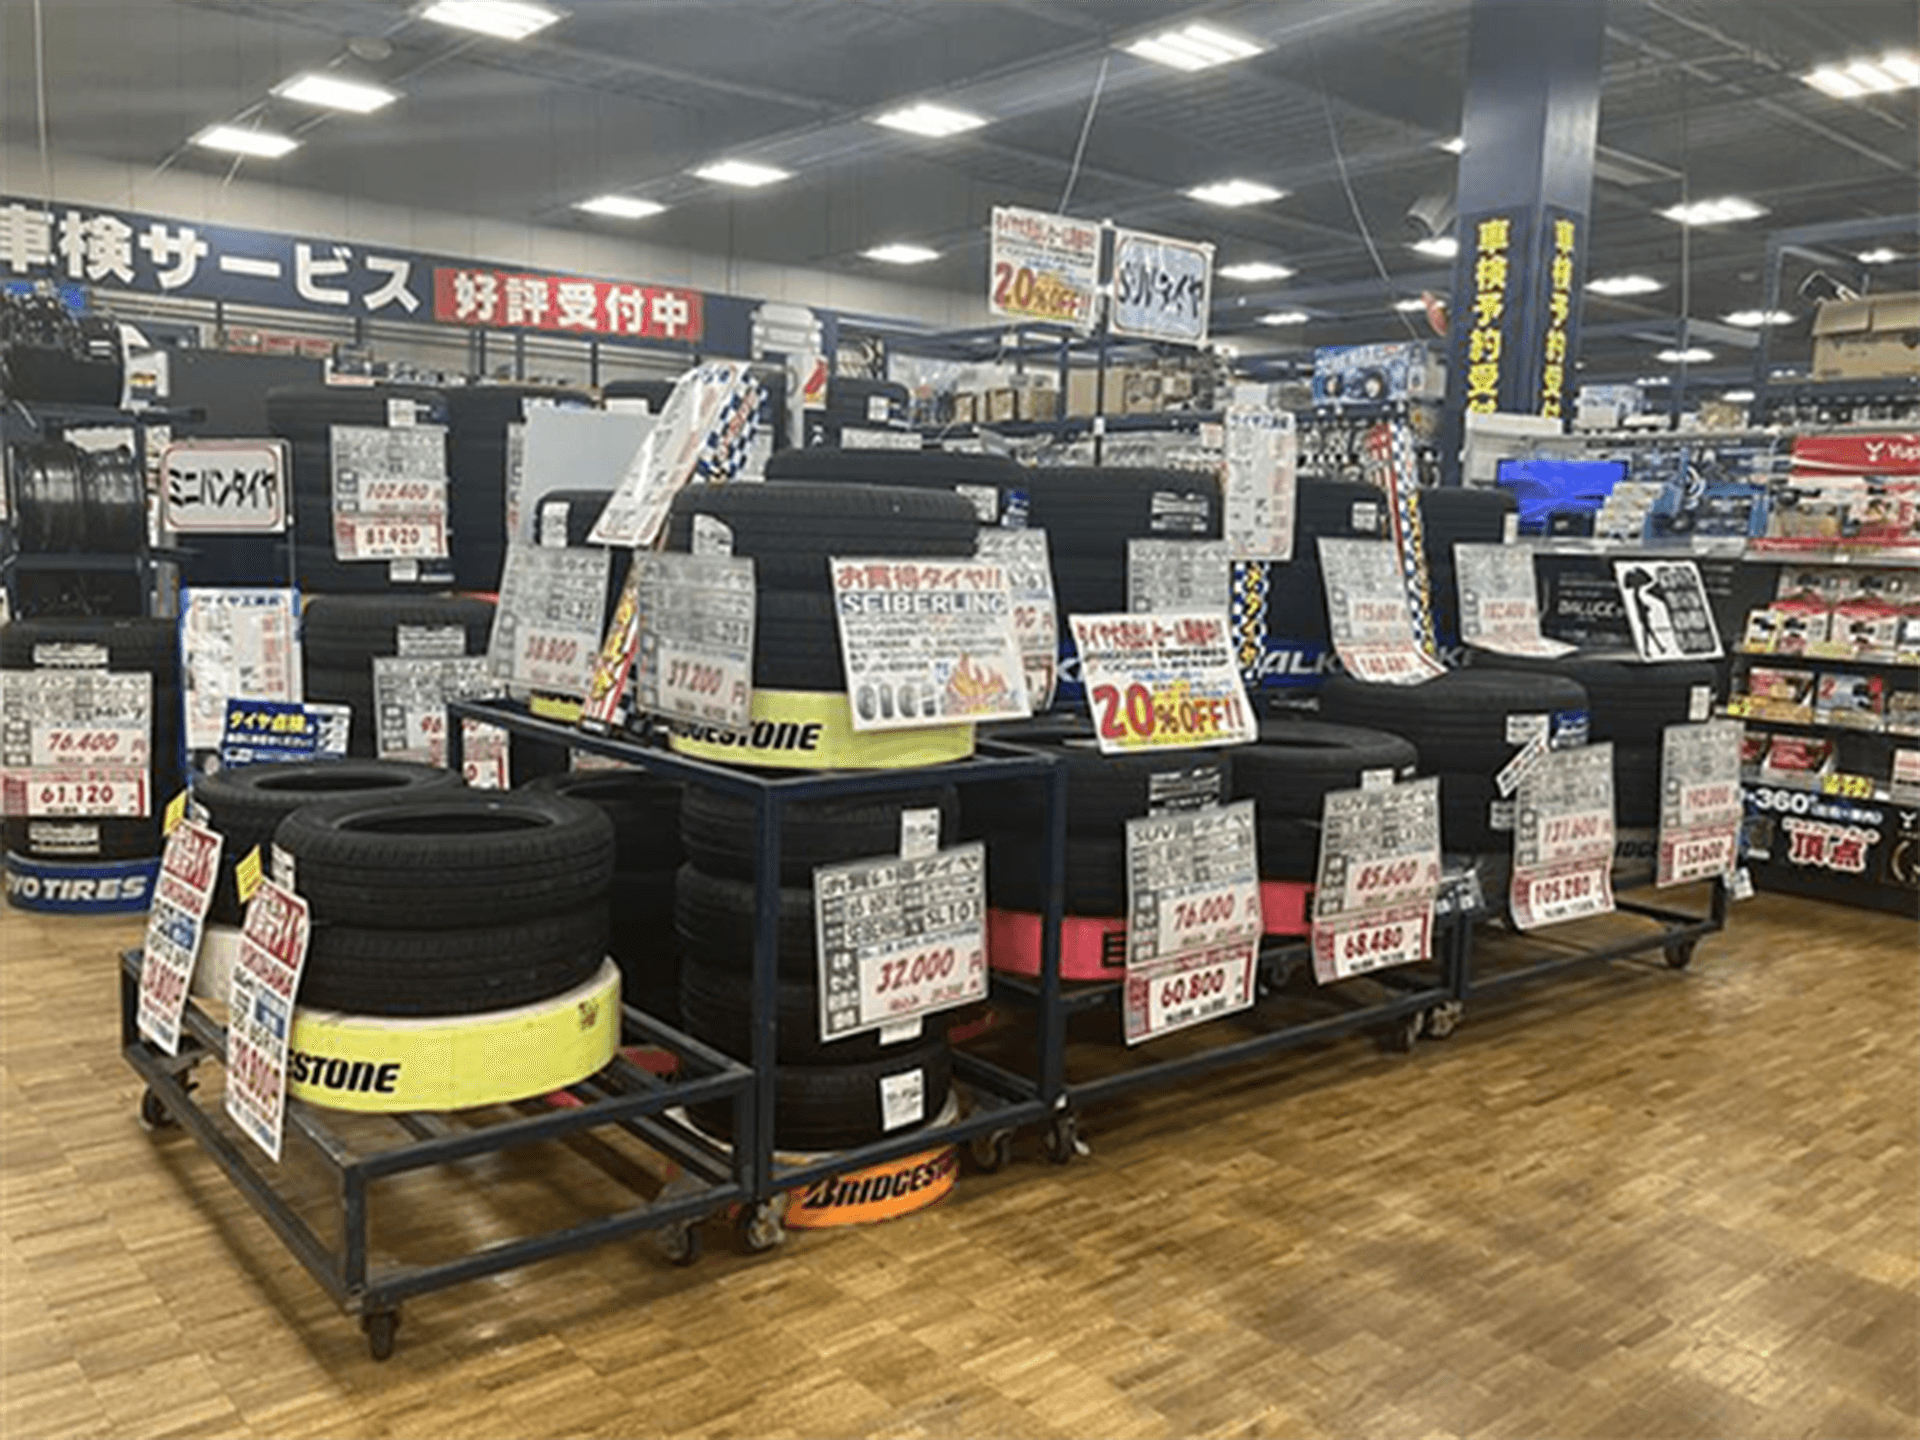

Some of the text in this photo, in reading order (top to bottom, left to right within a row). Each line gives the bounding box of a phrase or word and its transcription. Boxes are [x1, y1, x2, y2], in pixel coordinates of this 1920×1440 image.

[0, 204, 420, 313] 車検サービス
[453, 273, 691, 338] 好評受付中
[842, 592, 1008, 615] SEIBERLING
[40, 785, 114, 803] 61.120
